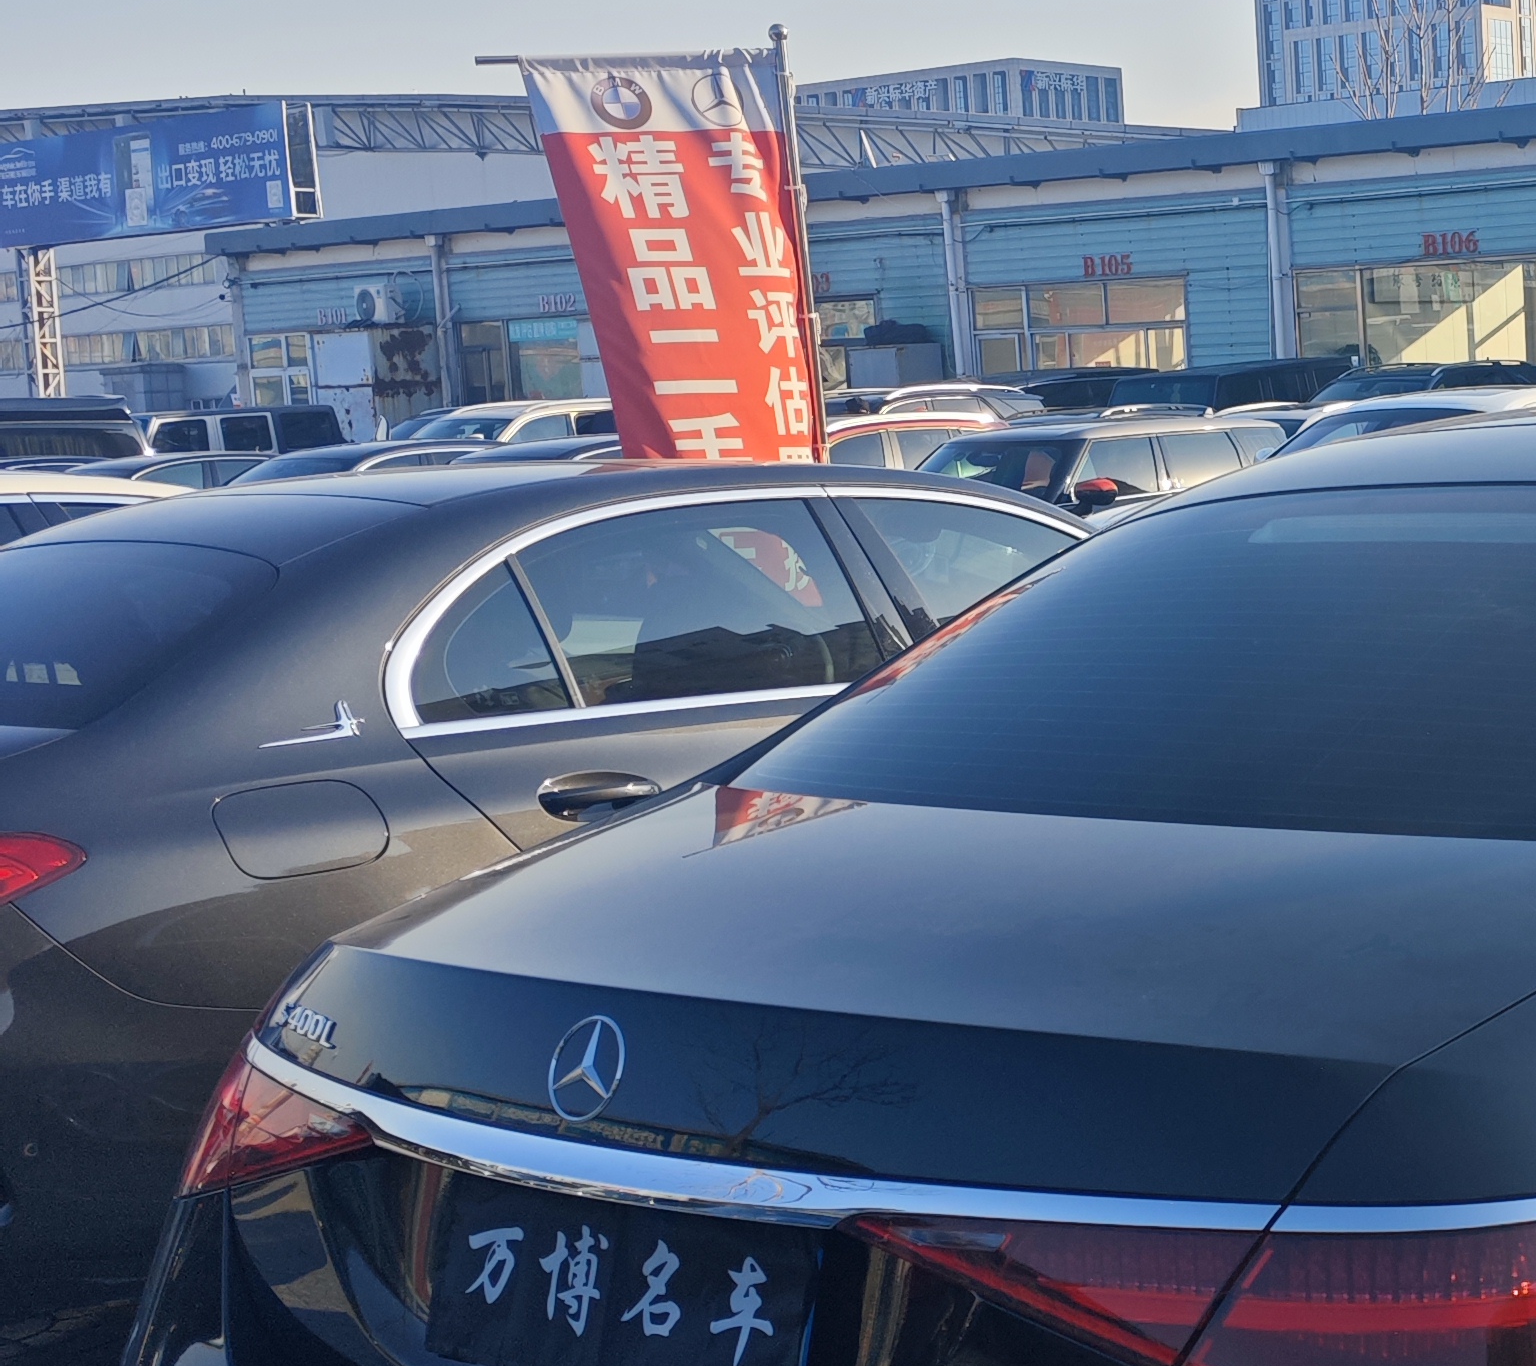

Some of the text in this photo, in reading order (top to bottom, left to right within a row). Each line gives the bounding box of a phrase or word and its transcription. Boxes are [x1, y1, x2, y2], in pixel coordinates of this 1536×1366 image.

[157, 148, 281, 190] 出口变现 轻松无忧
[1, 172, 112, 210] 车在你手 渠道我有
[1421, 230, 1479, 256] B106
[1083, 253, 1133, 278] B105
[540, 293, 576, 313] B102
[707, 131, 814, 463] 专业评估
[317, 307, 347, 326] B101
